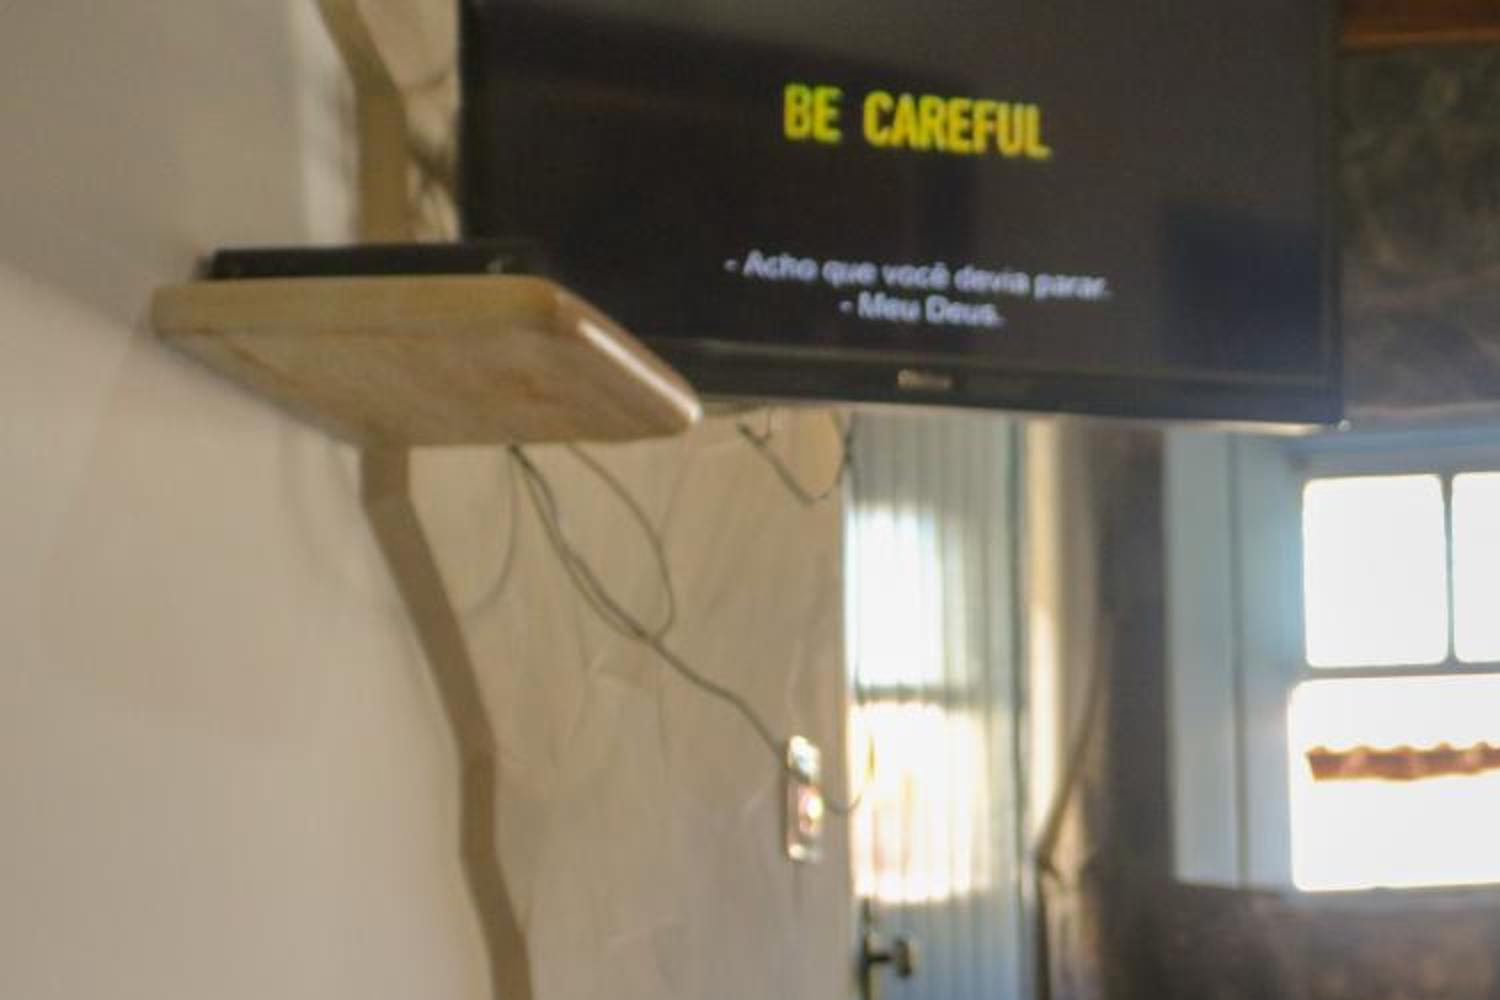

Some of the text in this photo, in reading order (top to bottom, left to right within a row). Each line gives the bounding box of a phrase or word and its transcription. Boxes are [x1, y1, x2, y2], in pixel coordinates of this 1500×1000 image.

[784, 84, 1051, 159] BE CAREFUL
[743, 249, 819, 281] Acho
[821, 260, 878, 288] que
[882, 261, 951, 291] você
[954, 266, 1032, 296] devia
[1033, 273, 1111, 301] parar.
[857, 290, 921, 322] Meu
[925, 294, 1004, 328] Deus.
